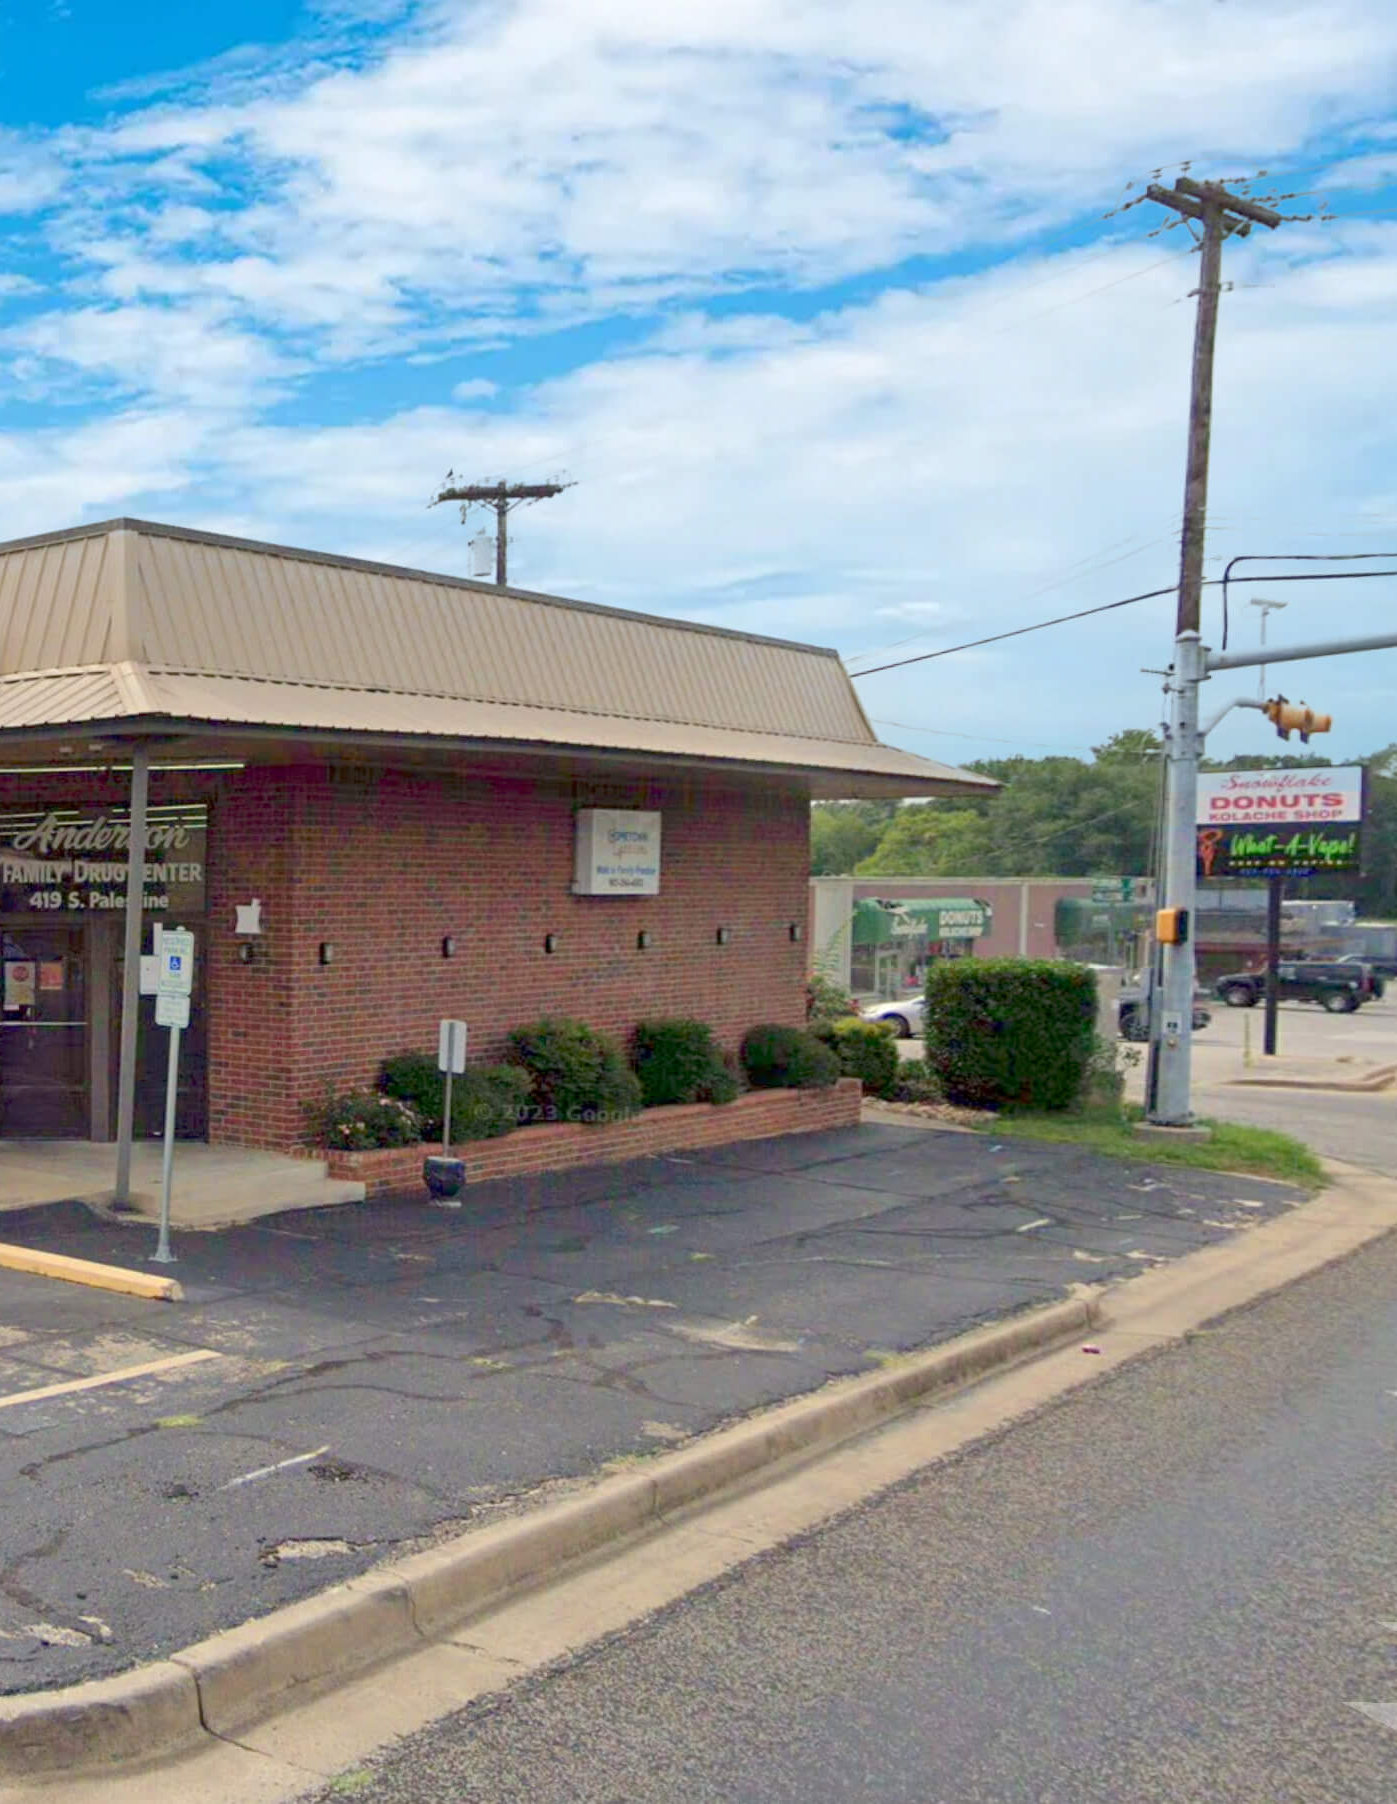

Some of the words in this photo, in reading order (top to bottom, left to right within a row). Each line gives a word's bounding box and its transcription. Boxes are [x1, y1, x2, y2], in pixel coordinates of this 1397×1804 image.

[1220, 772, 1333, 792] Snowflake
[1210, 793, 1343, 810] DONUTS
[1208, 811, 1287, 822] KOLACHE
[1293, 809, 1343, 821] SHOP
[13, 815, 190, 853] Anderon
[3, 860, 64, 883] FAMILY
[74, 859, 125, 882] DRUG
[143, 862, 202, 882] ENTER
[29, 891, 62, 909] 419
[68, 891, 85, 909] S.
[89, 891, 169, 909] Paleine
